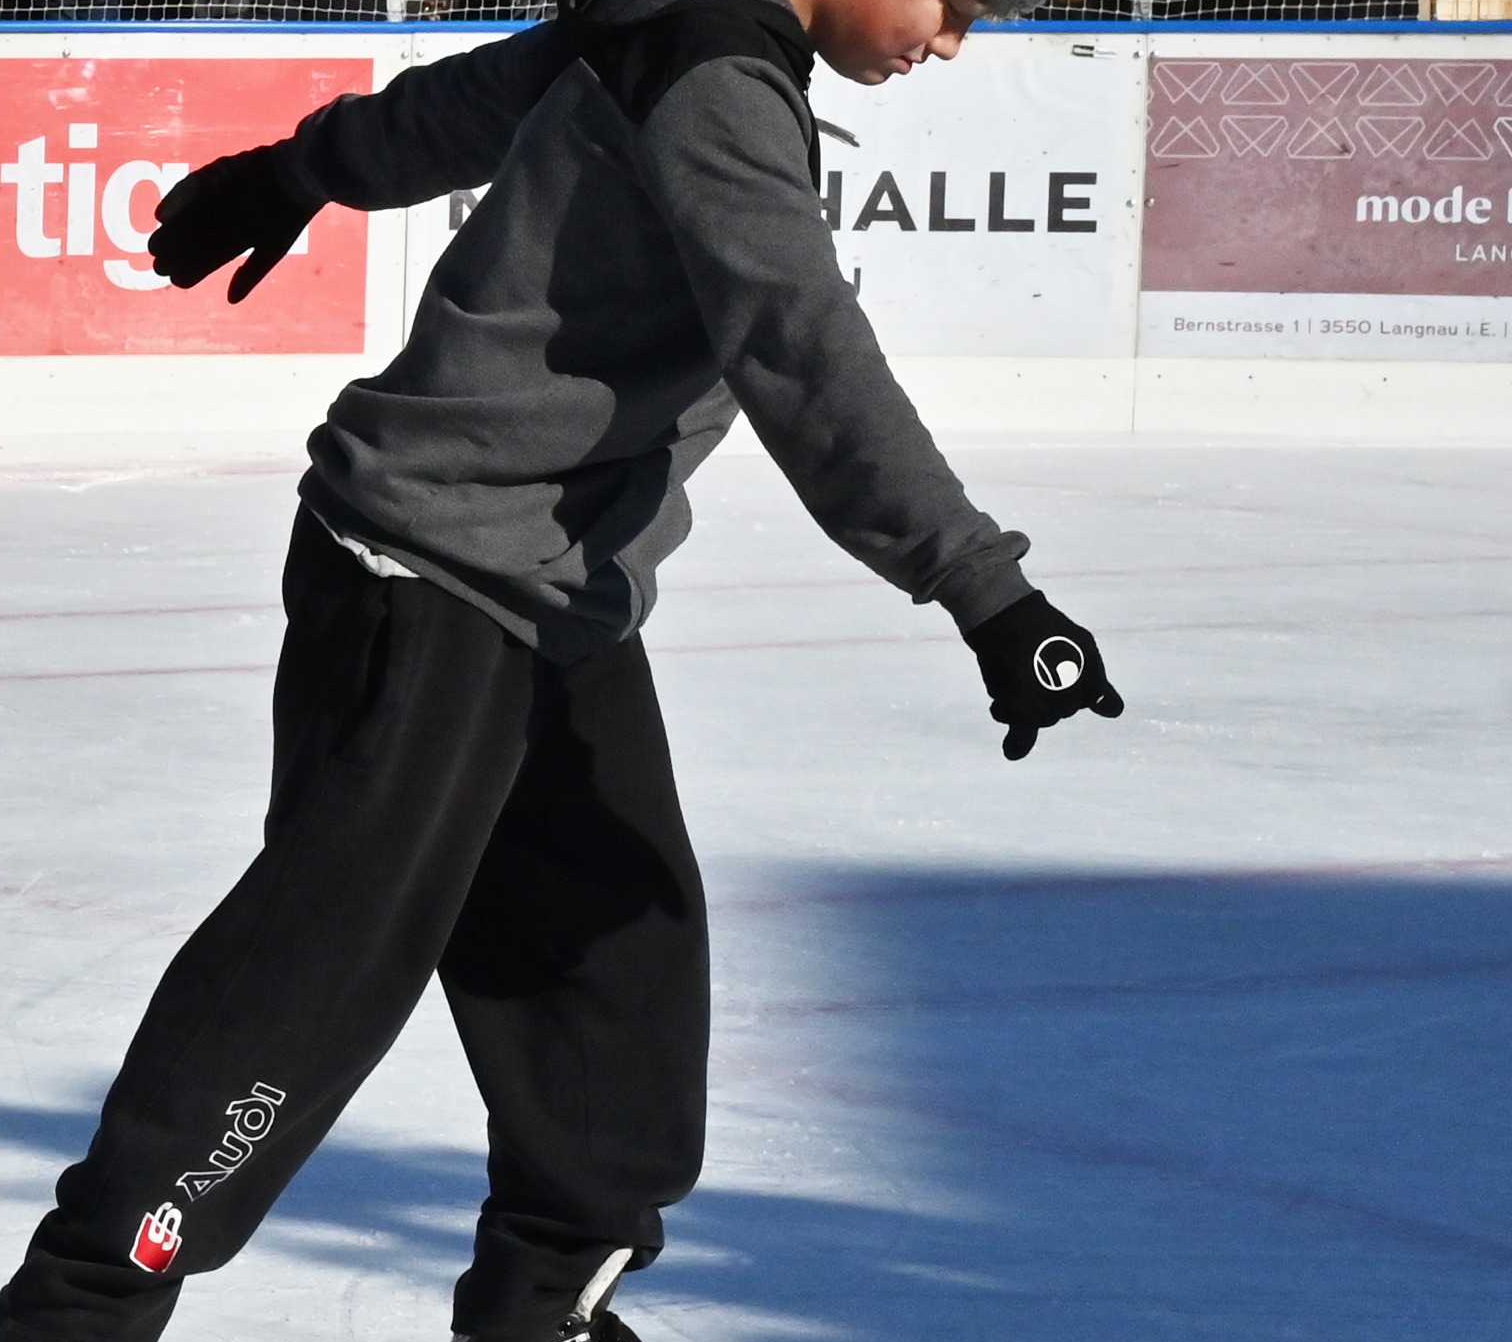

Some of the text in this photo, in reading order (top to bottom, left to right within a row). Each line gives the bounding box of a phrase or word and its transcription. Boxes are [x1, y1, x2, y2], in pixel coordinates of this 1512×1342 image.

[1356, 185, 1493, 225] mode
[1454, 244, 1512, 262] LAN
[1172, 317, 1285, 334] Bernstrasse
[1292, 318, 1300, 334] 1
[1320, 319, 1372, 335] 3550
[1379, 320, 1459, 340] Langnau
[1479, 321, 1498, 338] E.
